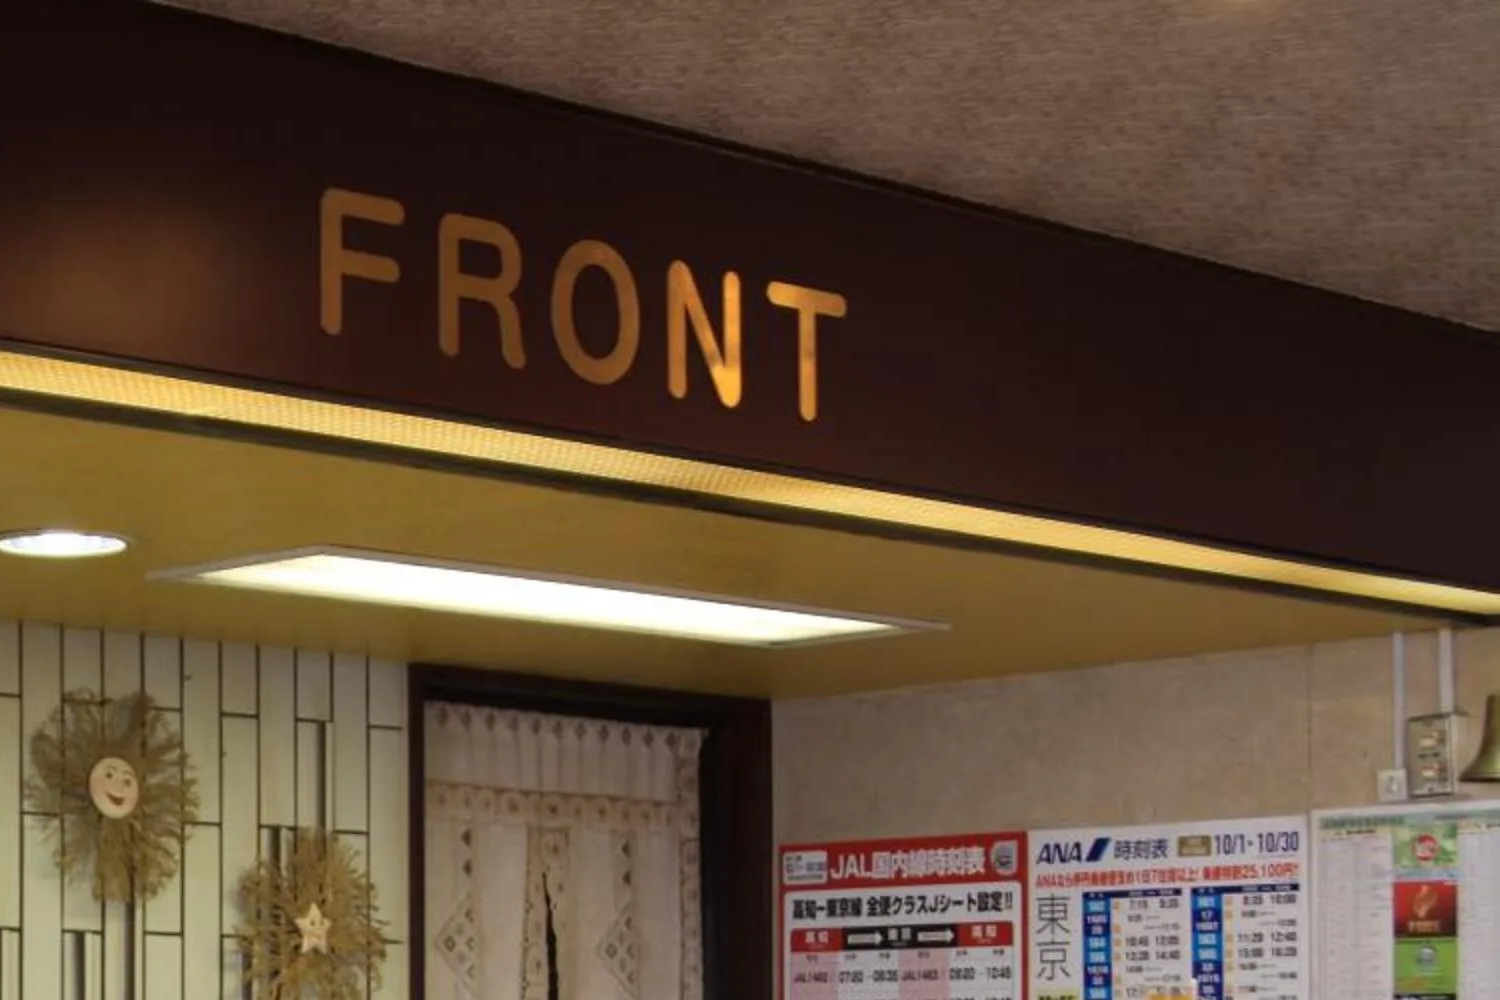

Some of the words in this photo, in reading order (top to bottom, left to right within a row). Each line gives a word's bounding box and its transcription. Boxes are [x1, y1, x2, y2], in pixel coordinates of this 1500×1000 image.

[320, 187, 848, 422] FRONT
[1036, 841, 1083, 864] ANA
[1036, 892, 1071, 981] 東京
